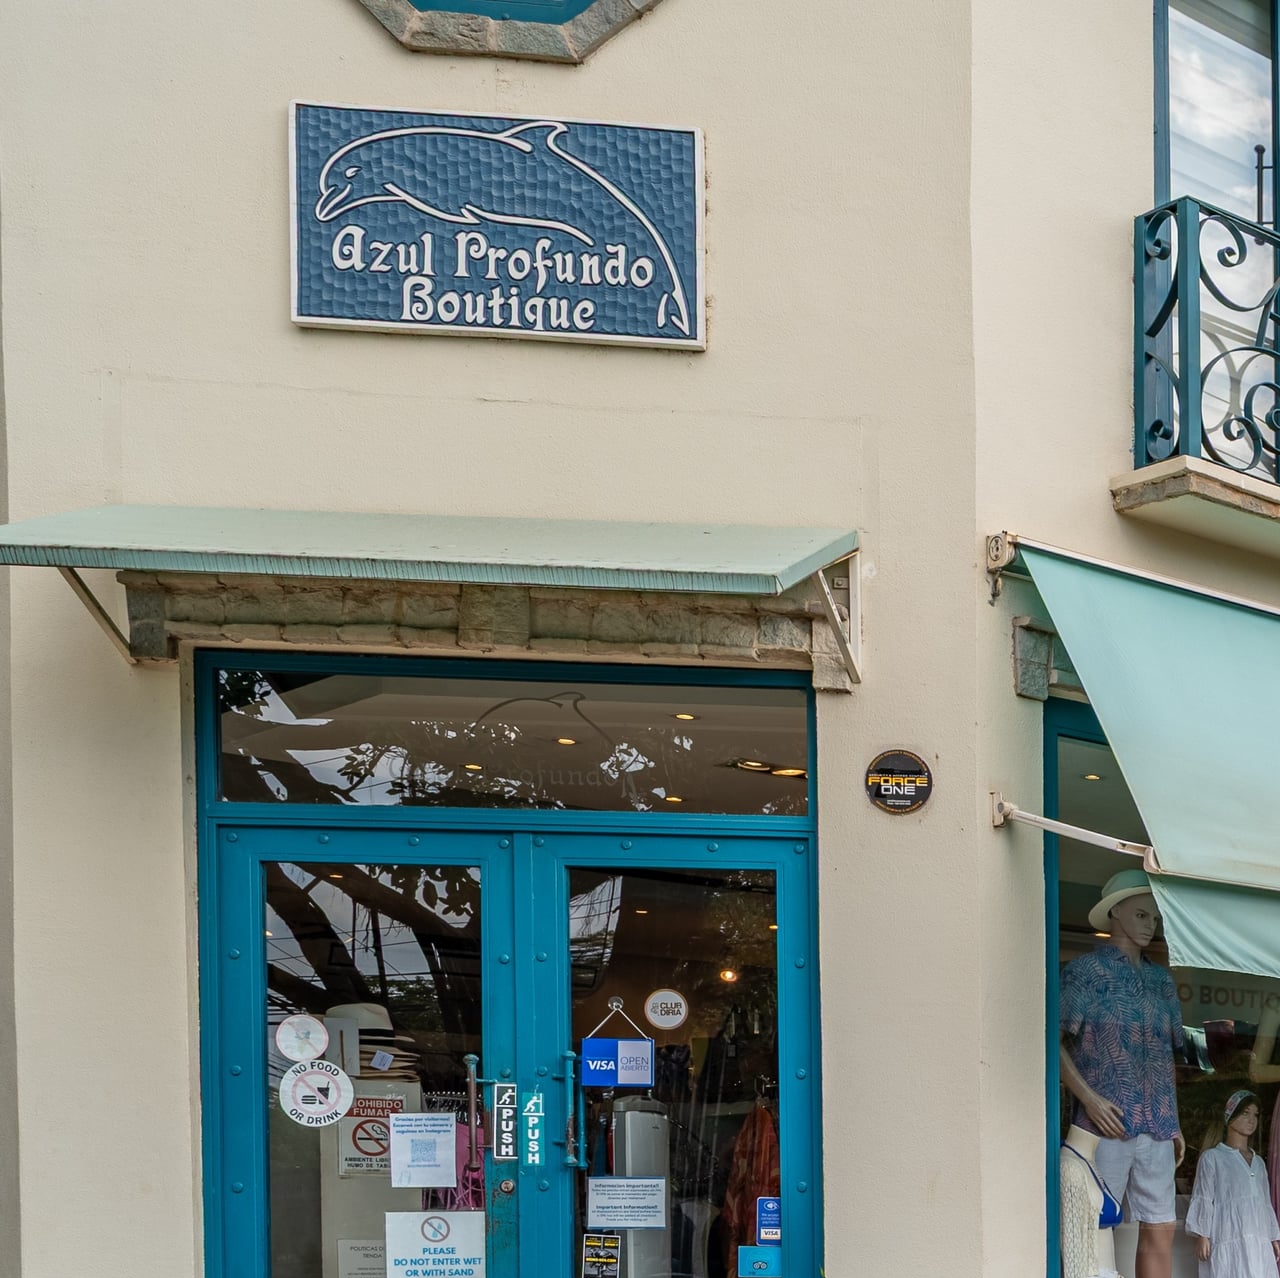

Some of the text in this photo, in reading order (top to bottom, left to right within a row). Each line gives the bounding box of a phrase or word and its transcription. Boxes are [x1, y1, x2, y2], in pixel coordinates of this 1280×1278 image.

[332, 225, 654, 292] Azul Profundo
[400, 275, 595, 331] Boutique
[868, 776, 928, 786] FORCE
[881, 786, 915, 795] ONE
[291, 1061, 340, 1077] NO FOOD
[586, 1056, 649, 1070] VISA OPEN
[289, 1108, 342, 1125] OR DRINK
[501, 1108, 514, 1156] PUSH
[527, 1116, 540, 1164] PUSH
[422, 1247, 456, 1255] PLEASE
[393, 1258, 408, 1266] DO
[463, 1257, 482, 1265] WET
[405, 1269, 419, 1277] OR
[448, 1268, 474, 1276] SAND
